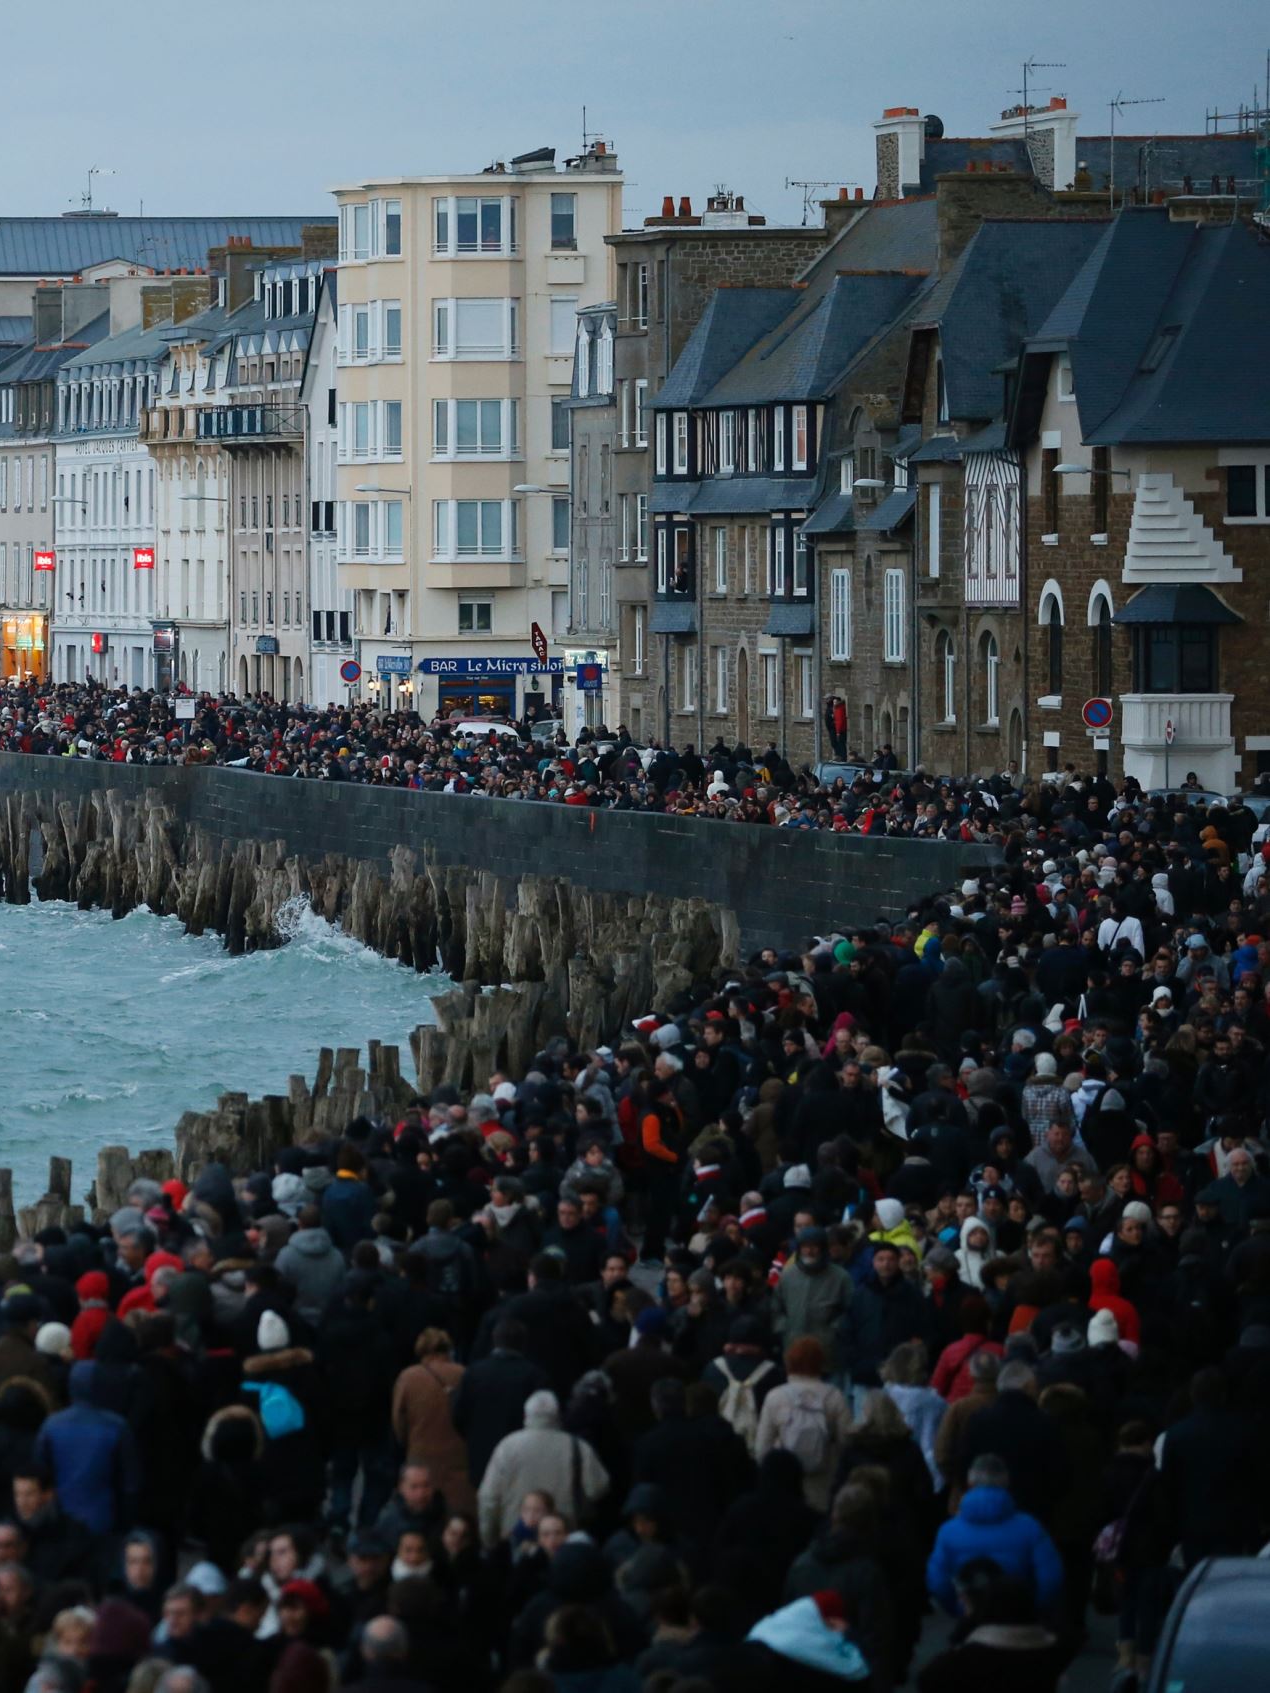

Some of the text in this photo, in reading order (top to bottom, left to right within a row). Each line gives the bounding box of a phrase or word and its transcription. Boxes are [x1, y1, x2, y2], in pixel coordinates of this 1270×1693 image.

[37, 555, 52, 565] ibis
[136, 553, 152, 563] ibis
[534, 631, 545, 656] TABAC
[431, 660, 458, 672] BAR
[467, 659, 482, 672] Le
